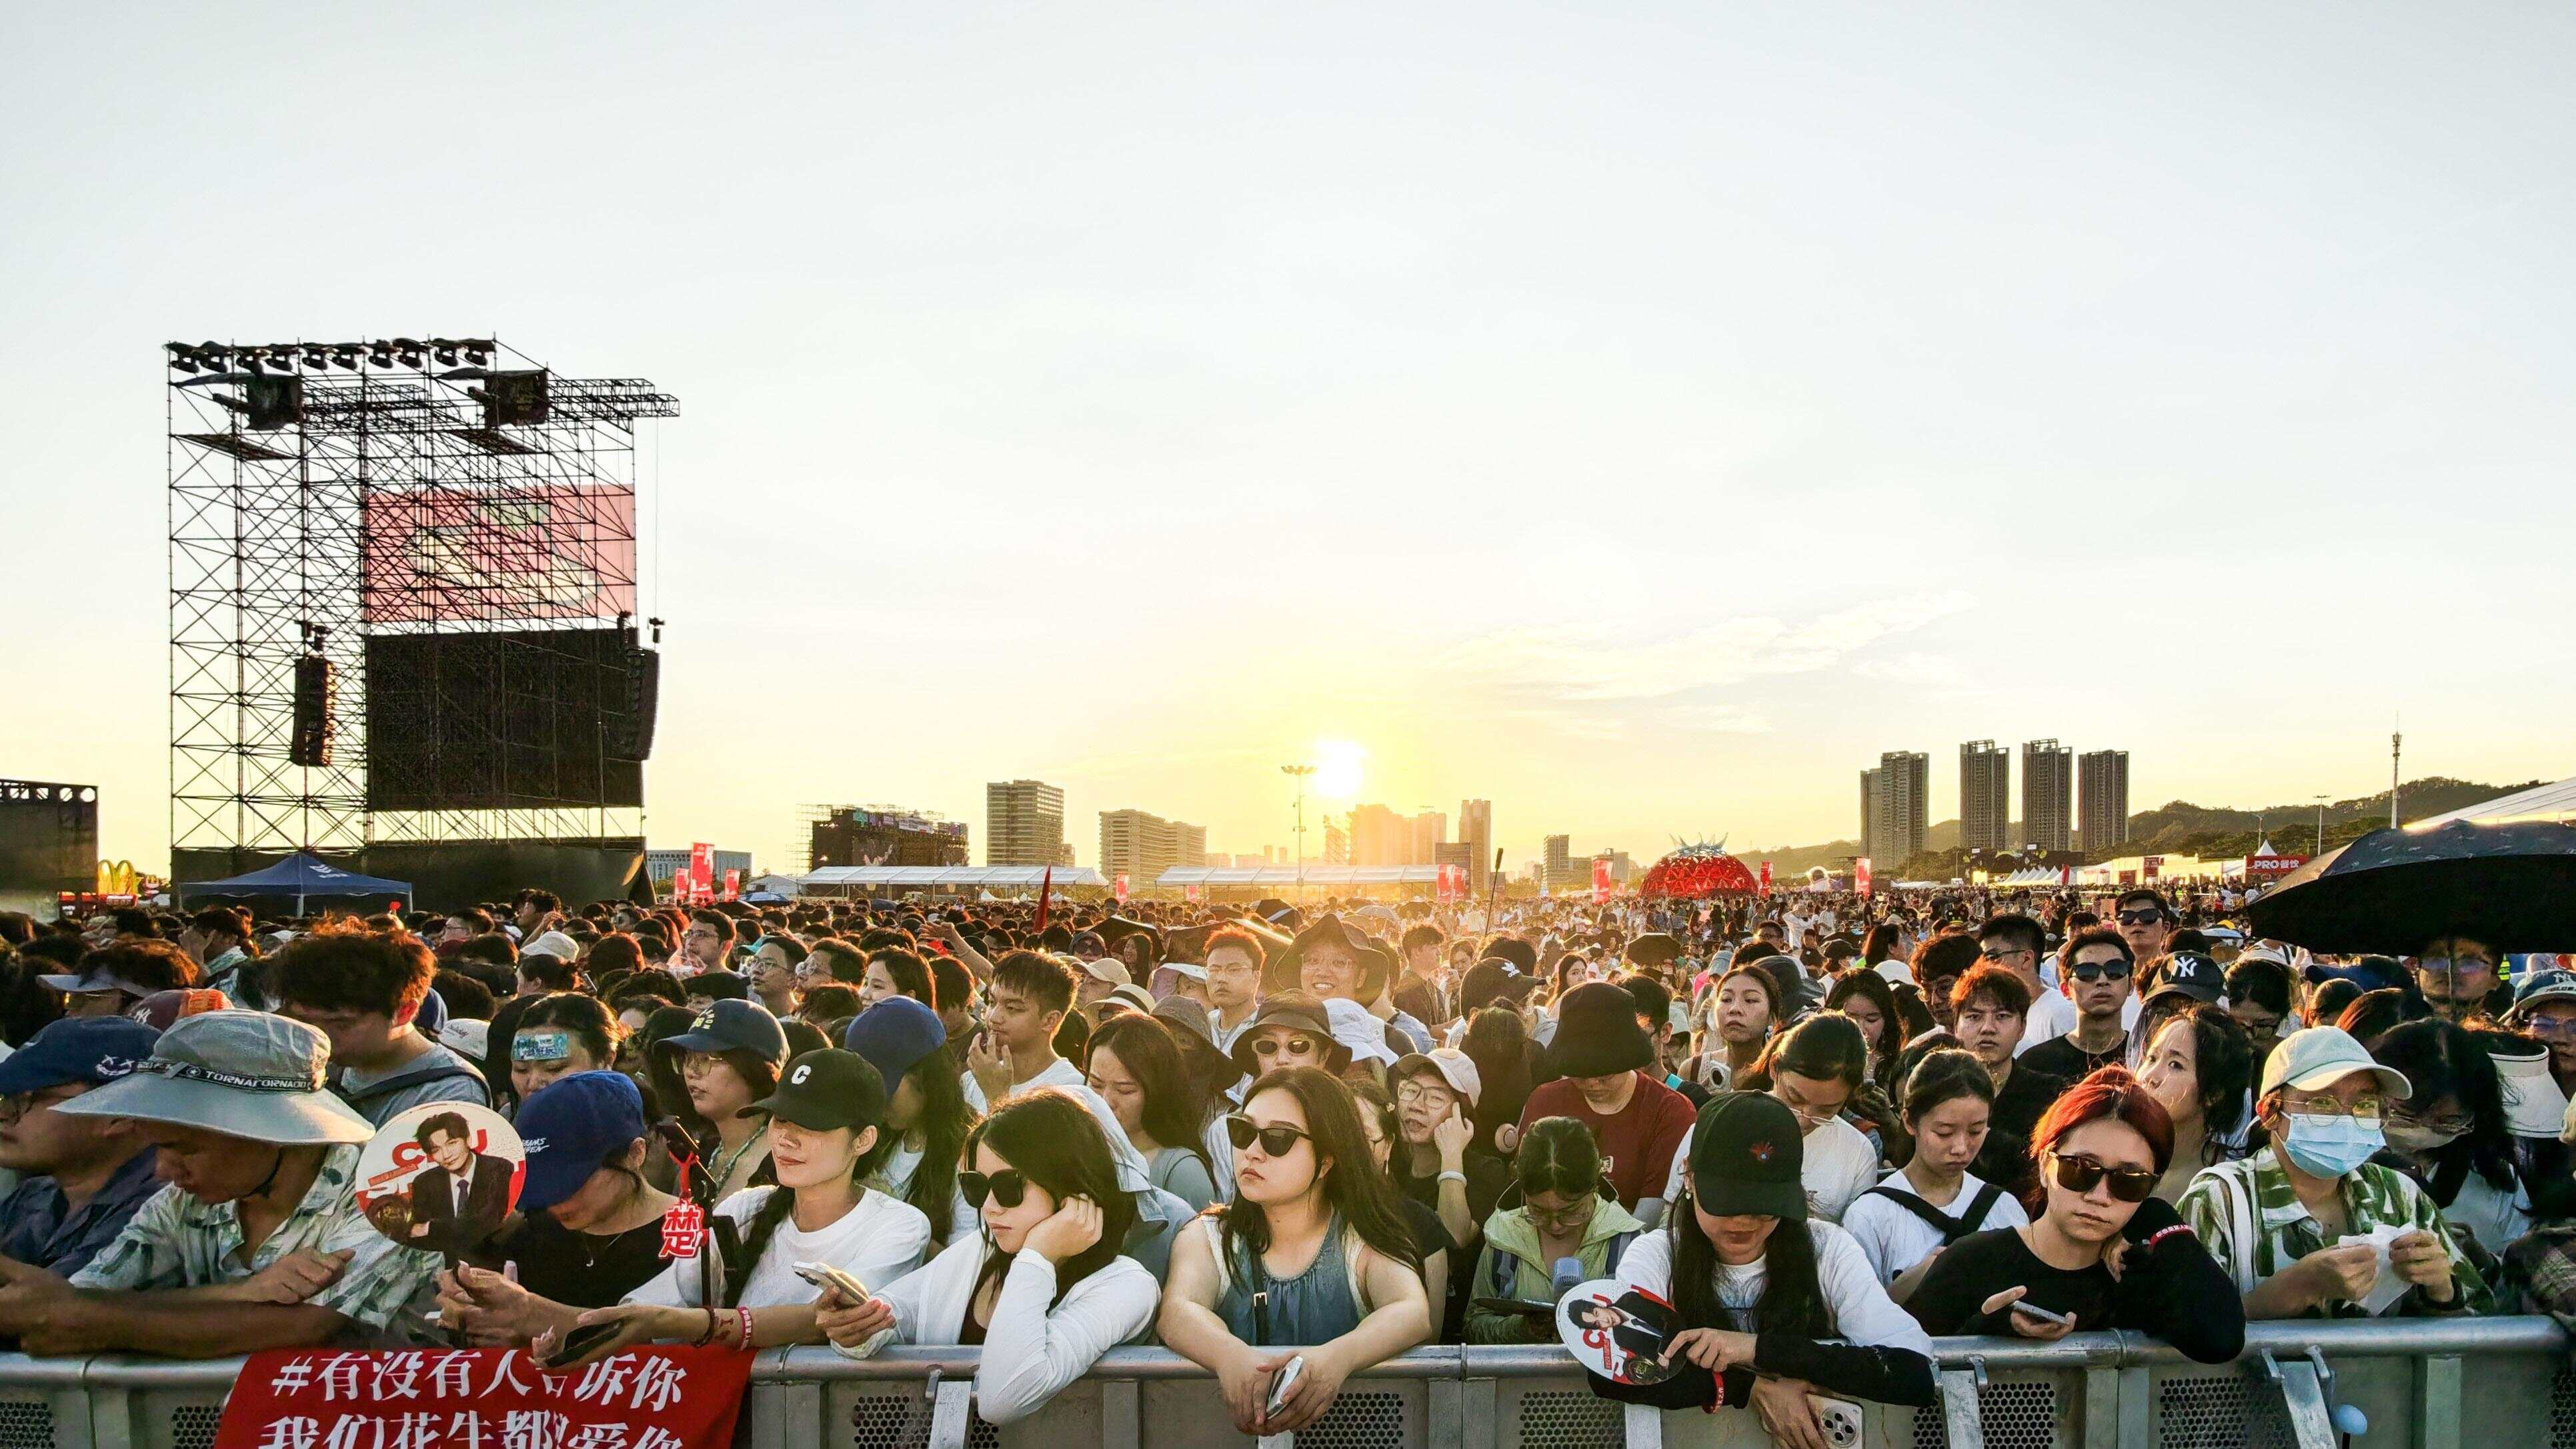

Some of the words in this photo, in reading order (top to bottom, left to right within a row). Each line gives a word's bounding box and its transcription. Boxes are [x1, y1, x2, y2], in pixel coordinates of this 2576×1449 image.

[2254, 860, 2279, 870] PRO
[2171, 956, 2197, 978] NY
[792, 1065, 812, 1085] C
